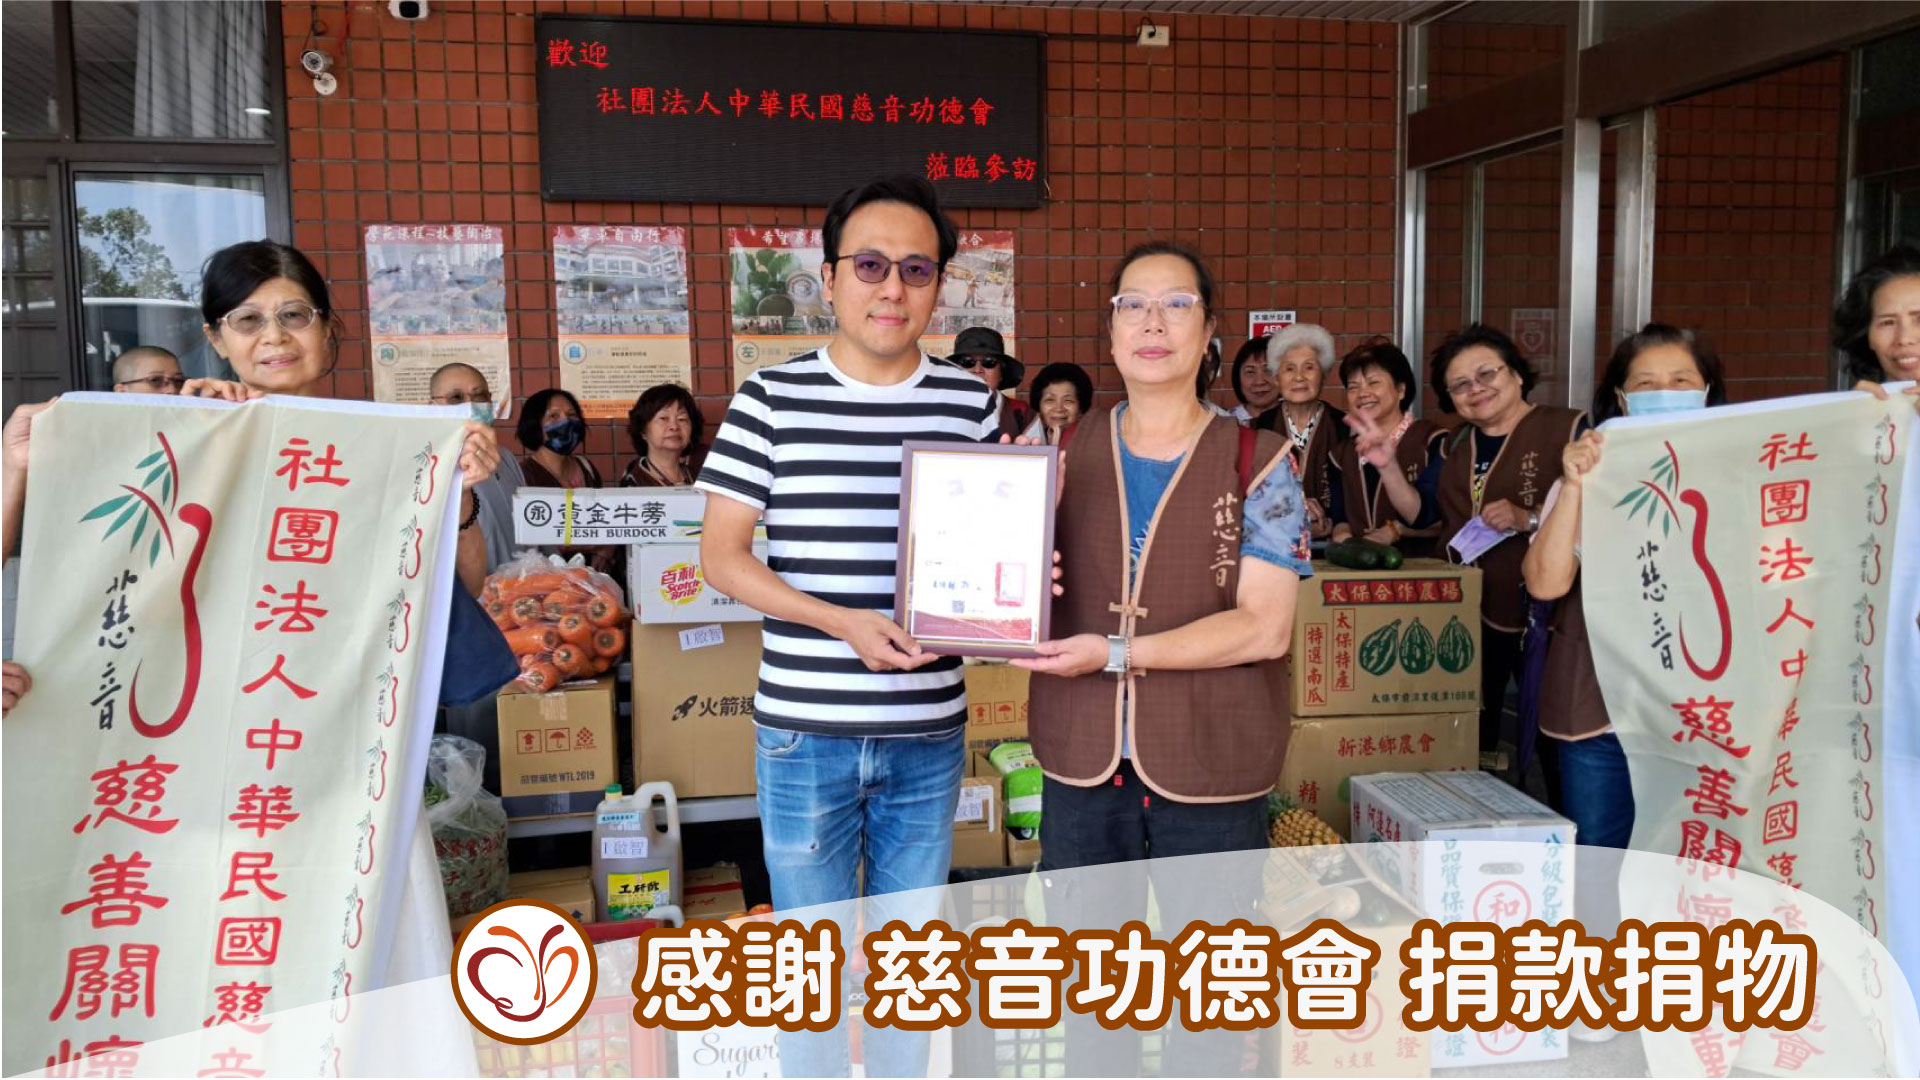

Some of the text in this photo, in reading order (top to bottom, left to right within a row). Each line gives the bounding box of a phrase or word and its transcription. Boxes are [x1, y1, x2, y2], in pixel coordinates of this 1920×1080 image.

[546, 38, 610, 69] 歡迎
[596, 86, 996, 127] 社團法人中華民國慈音功德會
[924, 151, 1038, 182] 蒞臨參訪
[606, 528, 667, 538] BURDOCK
[661, 564, 696, 586] 百利
[1330, 580, 1460, 602] 太保合作農場
[1307, 627, 1325, 703] 特選南瓜
[1335, 611, 1353, 689] 太保特產
[1338, 732, 1436, 757] 新港鄉農會
